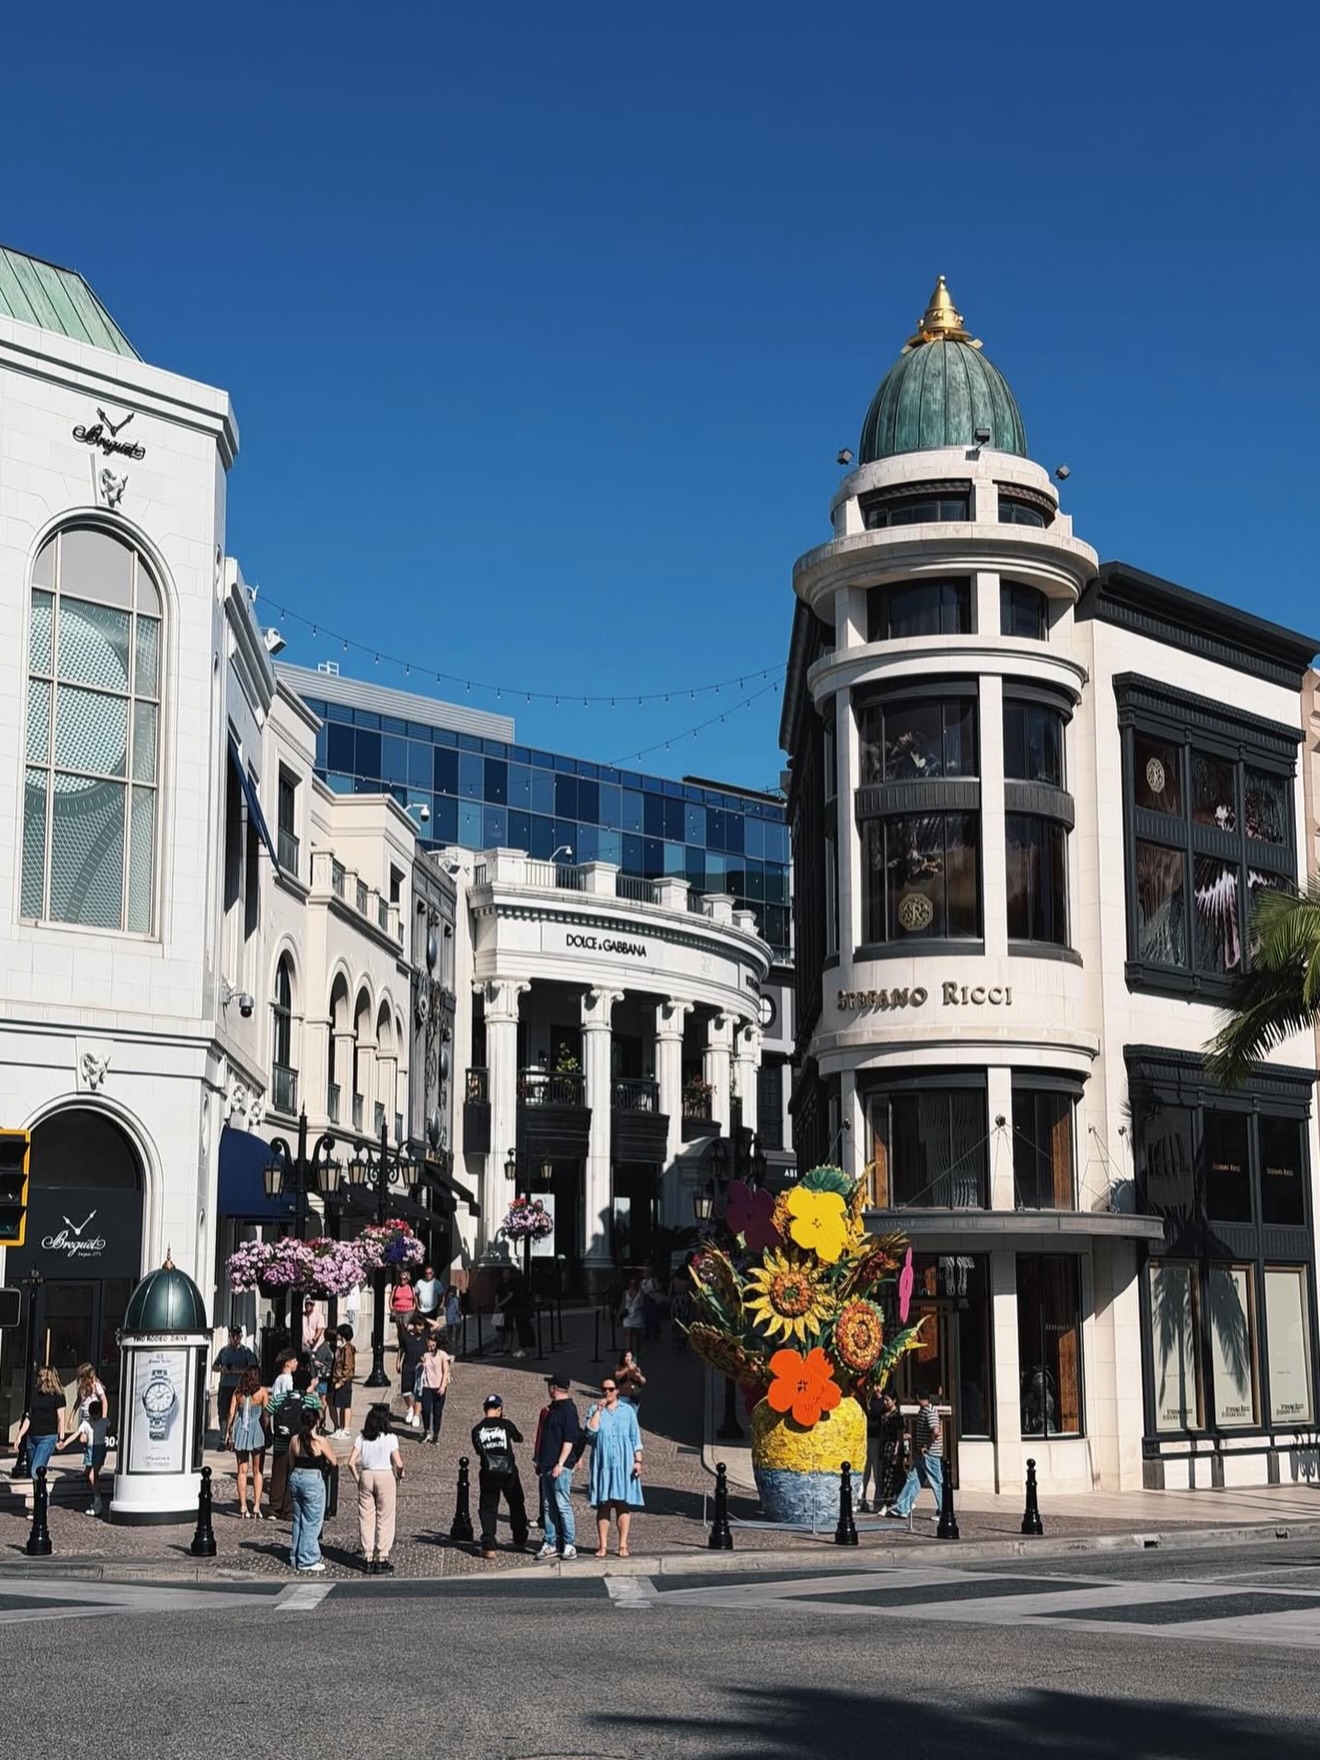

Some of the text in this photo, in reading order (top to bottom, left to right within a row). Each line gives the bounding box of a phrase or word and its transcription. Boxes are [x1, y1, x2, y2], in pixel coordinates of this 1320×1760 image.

[566, 933, 597, 950] DOLCE
[602, 939, 647, 958] GABBANA
[941, 981, 1012, 1006] RICCI
[41, 1230, 106, 1257] Breguet
